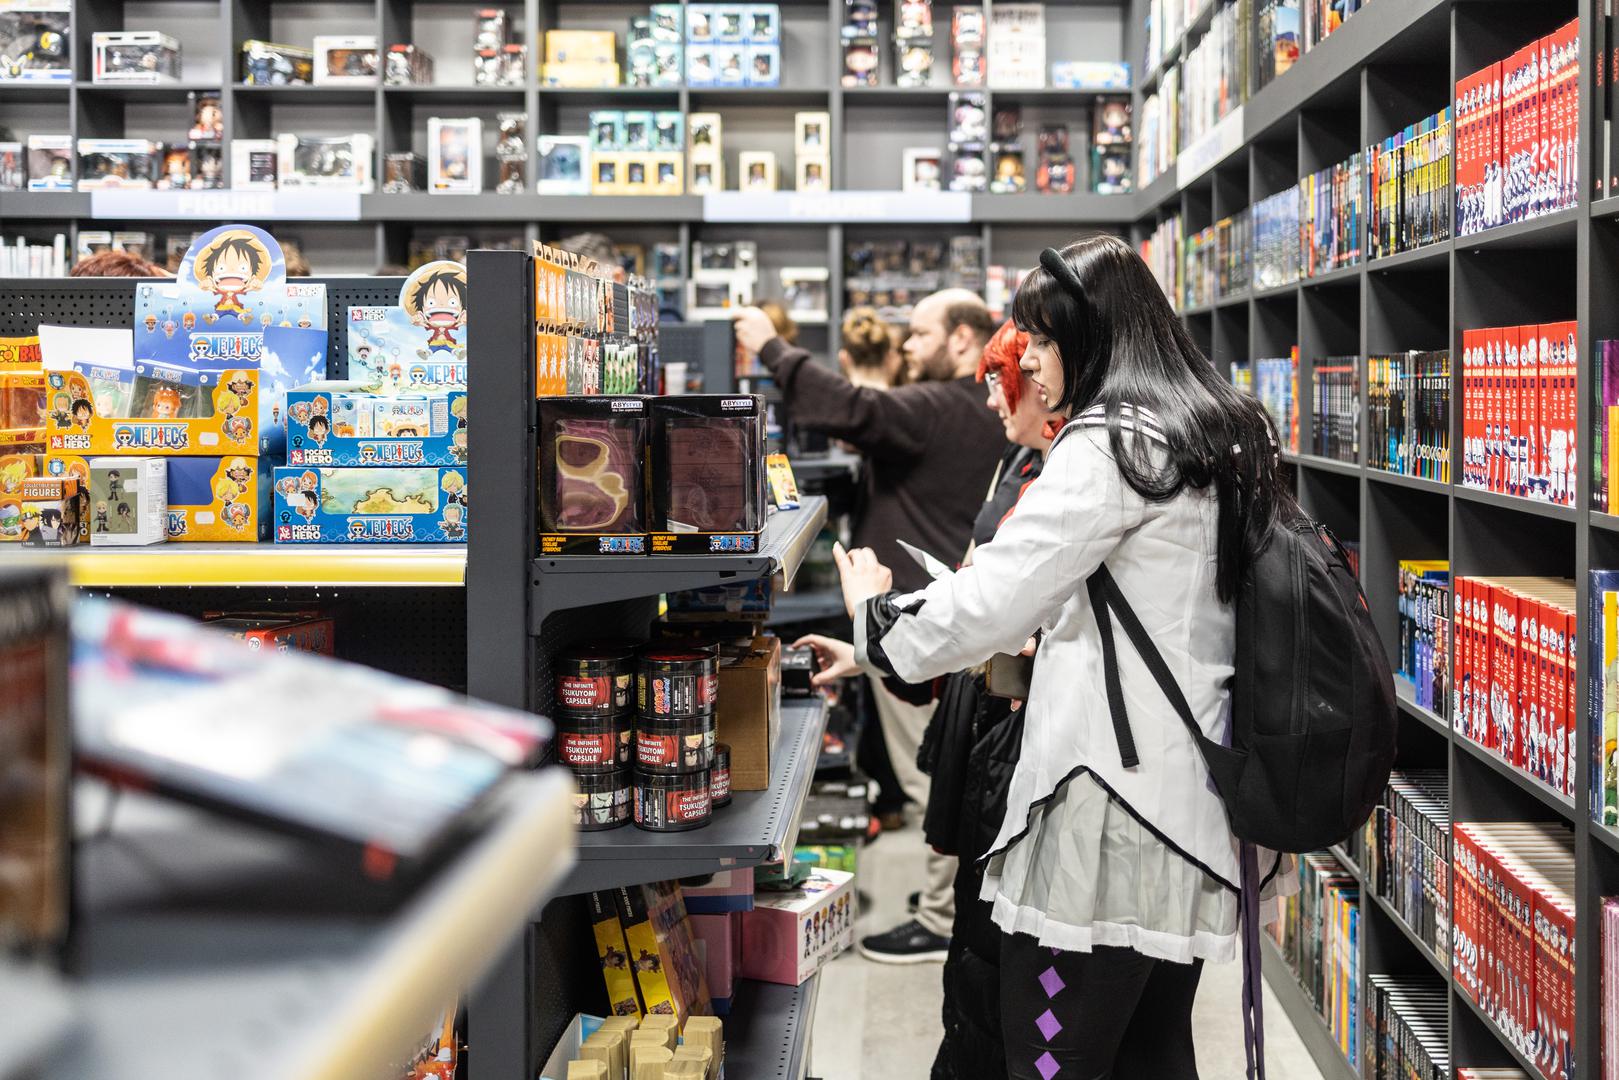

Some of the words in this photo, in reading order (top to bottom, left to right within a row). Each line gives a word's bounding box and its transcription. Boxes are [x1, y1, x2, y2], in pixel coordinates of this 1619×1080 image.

[19, 344, 42, 362] BAL
[304, 455, 332, 464] HERO
[292, 531, 320, 539] HERO
[250, 640, 259, 648] 79
[640, 754, 660, 762] CAPSULE
[680, 800, 709, 811] TSUKUYOMI
[684, 808, 706, 818] CAPSULE
